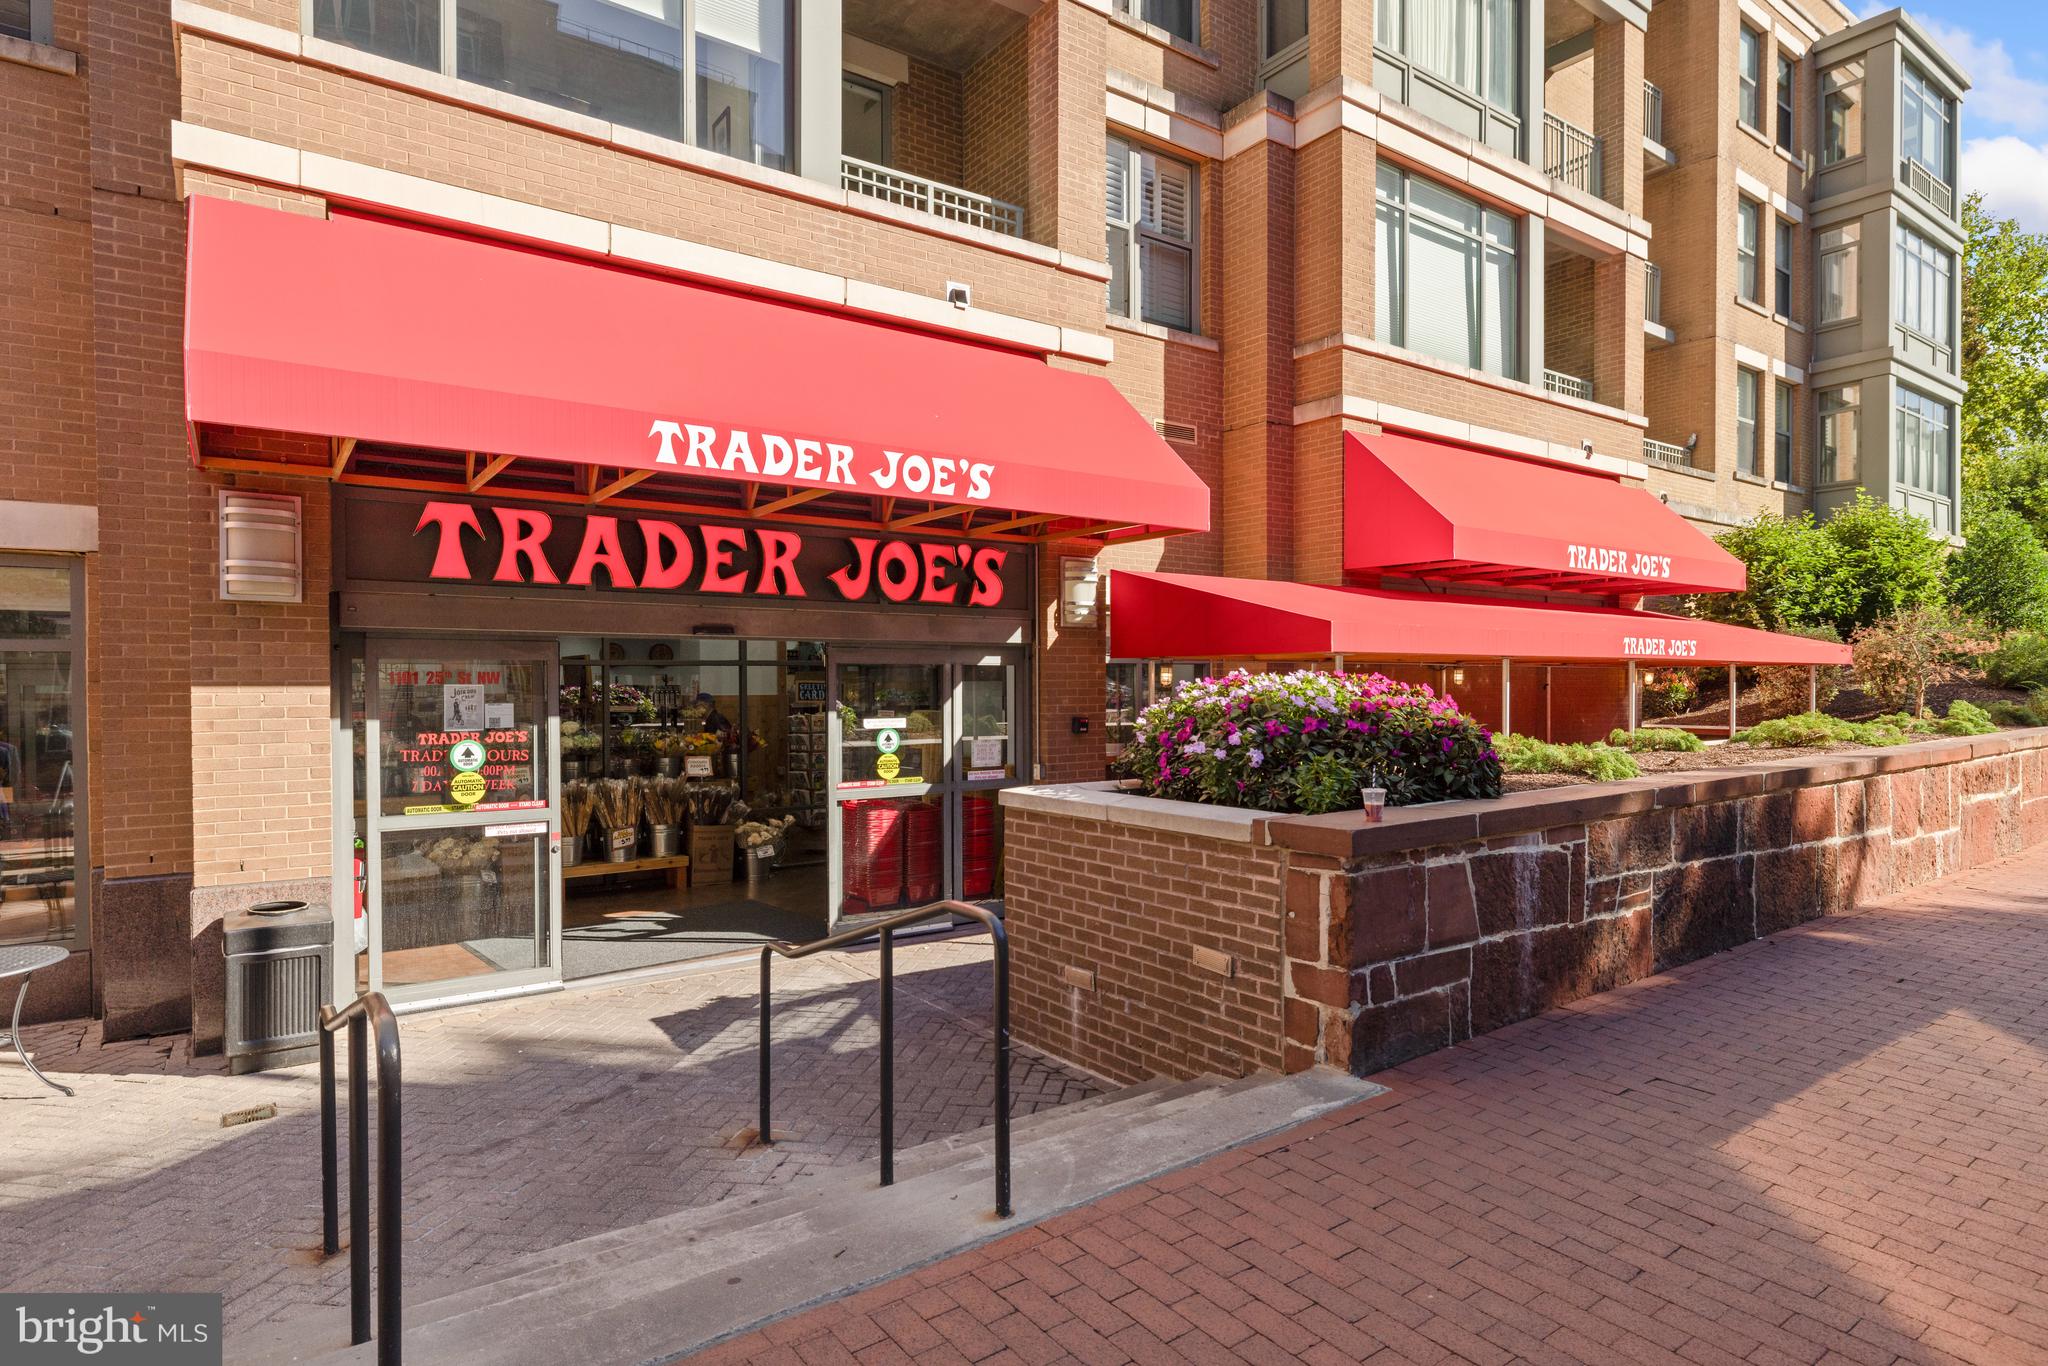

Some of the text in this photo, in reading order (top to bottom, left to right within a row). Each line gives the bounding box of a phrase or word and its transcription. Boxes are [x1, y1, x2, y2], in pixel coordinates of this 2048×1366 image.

[648, 420, 995, 499] TRADER JOE'S
[413, 501, 1008, 607] TRADER JOE'S
[1568, 545, 1671, 578] TRADER JOE'S
[1623, 637, 1697, 656] TRADER JOE'S
[388, 671, 419, 686] 1101
[477, 671, 501, 684] NW
[418, 731, 529, 745] TRADER JOE'S
[400, 749, 529, 762] TRAD OURS
[452, 784, 484, 792] CAUTION
